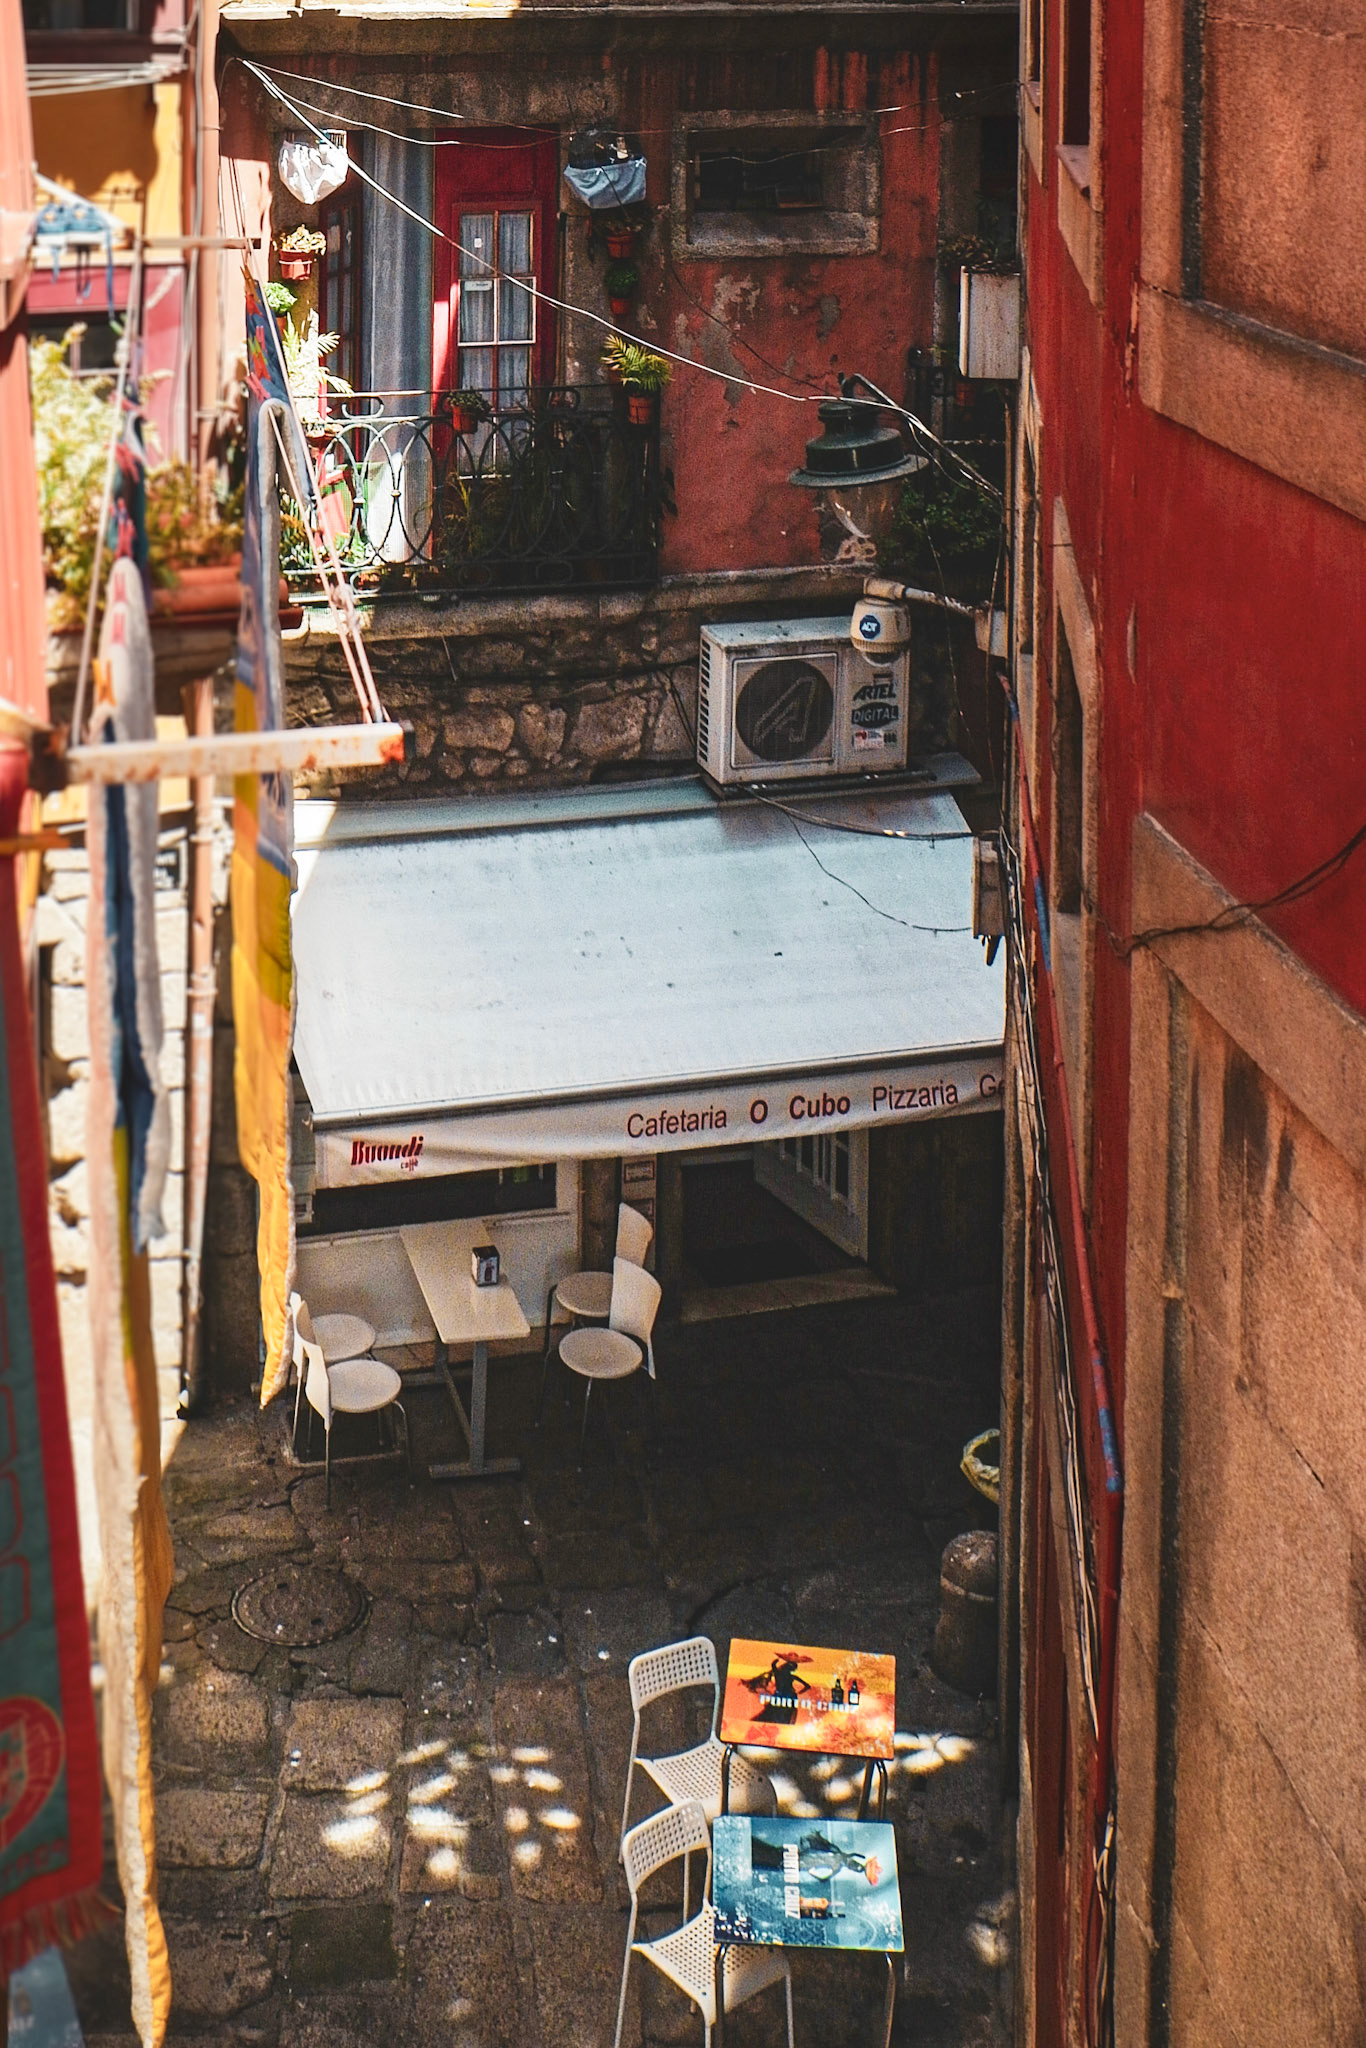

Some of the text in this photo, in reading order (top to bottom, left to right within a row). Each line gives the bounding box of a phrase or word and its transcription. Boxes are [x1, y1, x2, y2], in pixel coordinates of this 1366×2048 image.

[853, 707, 898, 723] DIGITAL
[627, 1105, 728, 1139] Cafetaria
[750, 1099, 769, 1125] O
[789, 1092, 851, 1120] Cubo
[872, 1079, 960, 1112] Pizzaria
[350, 1136, 425, 1166] Buondi
